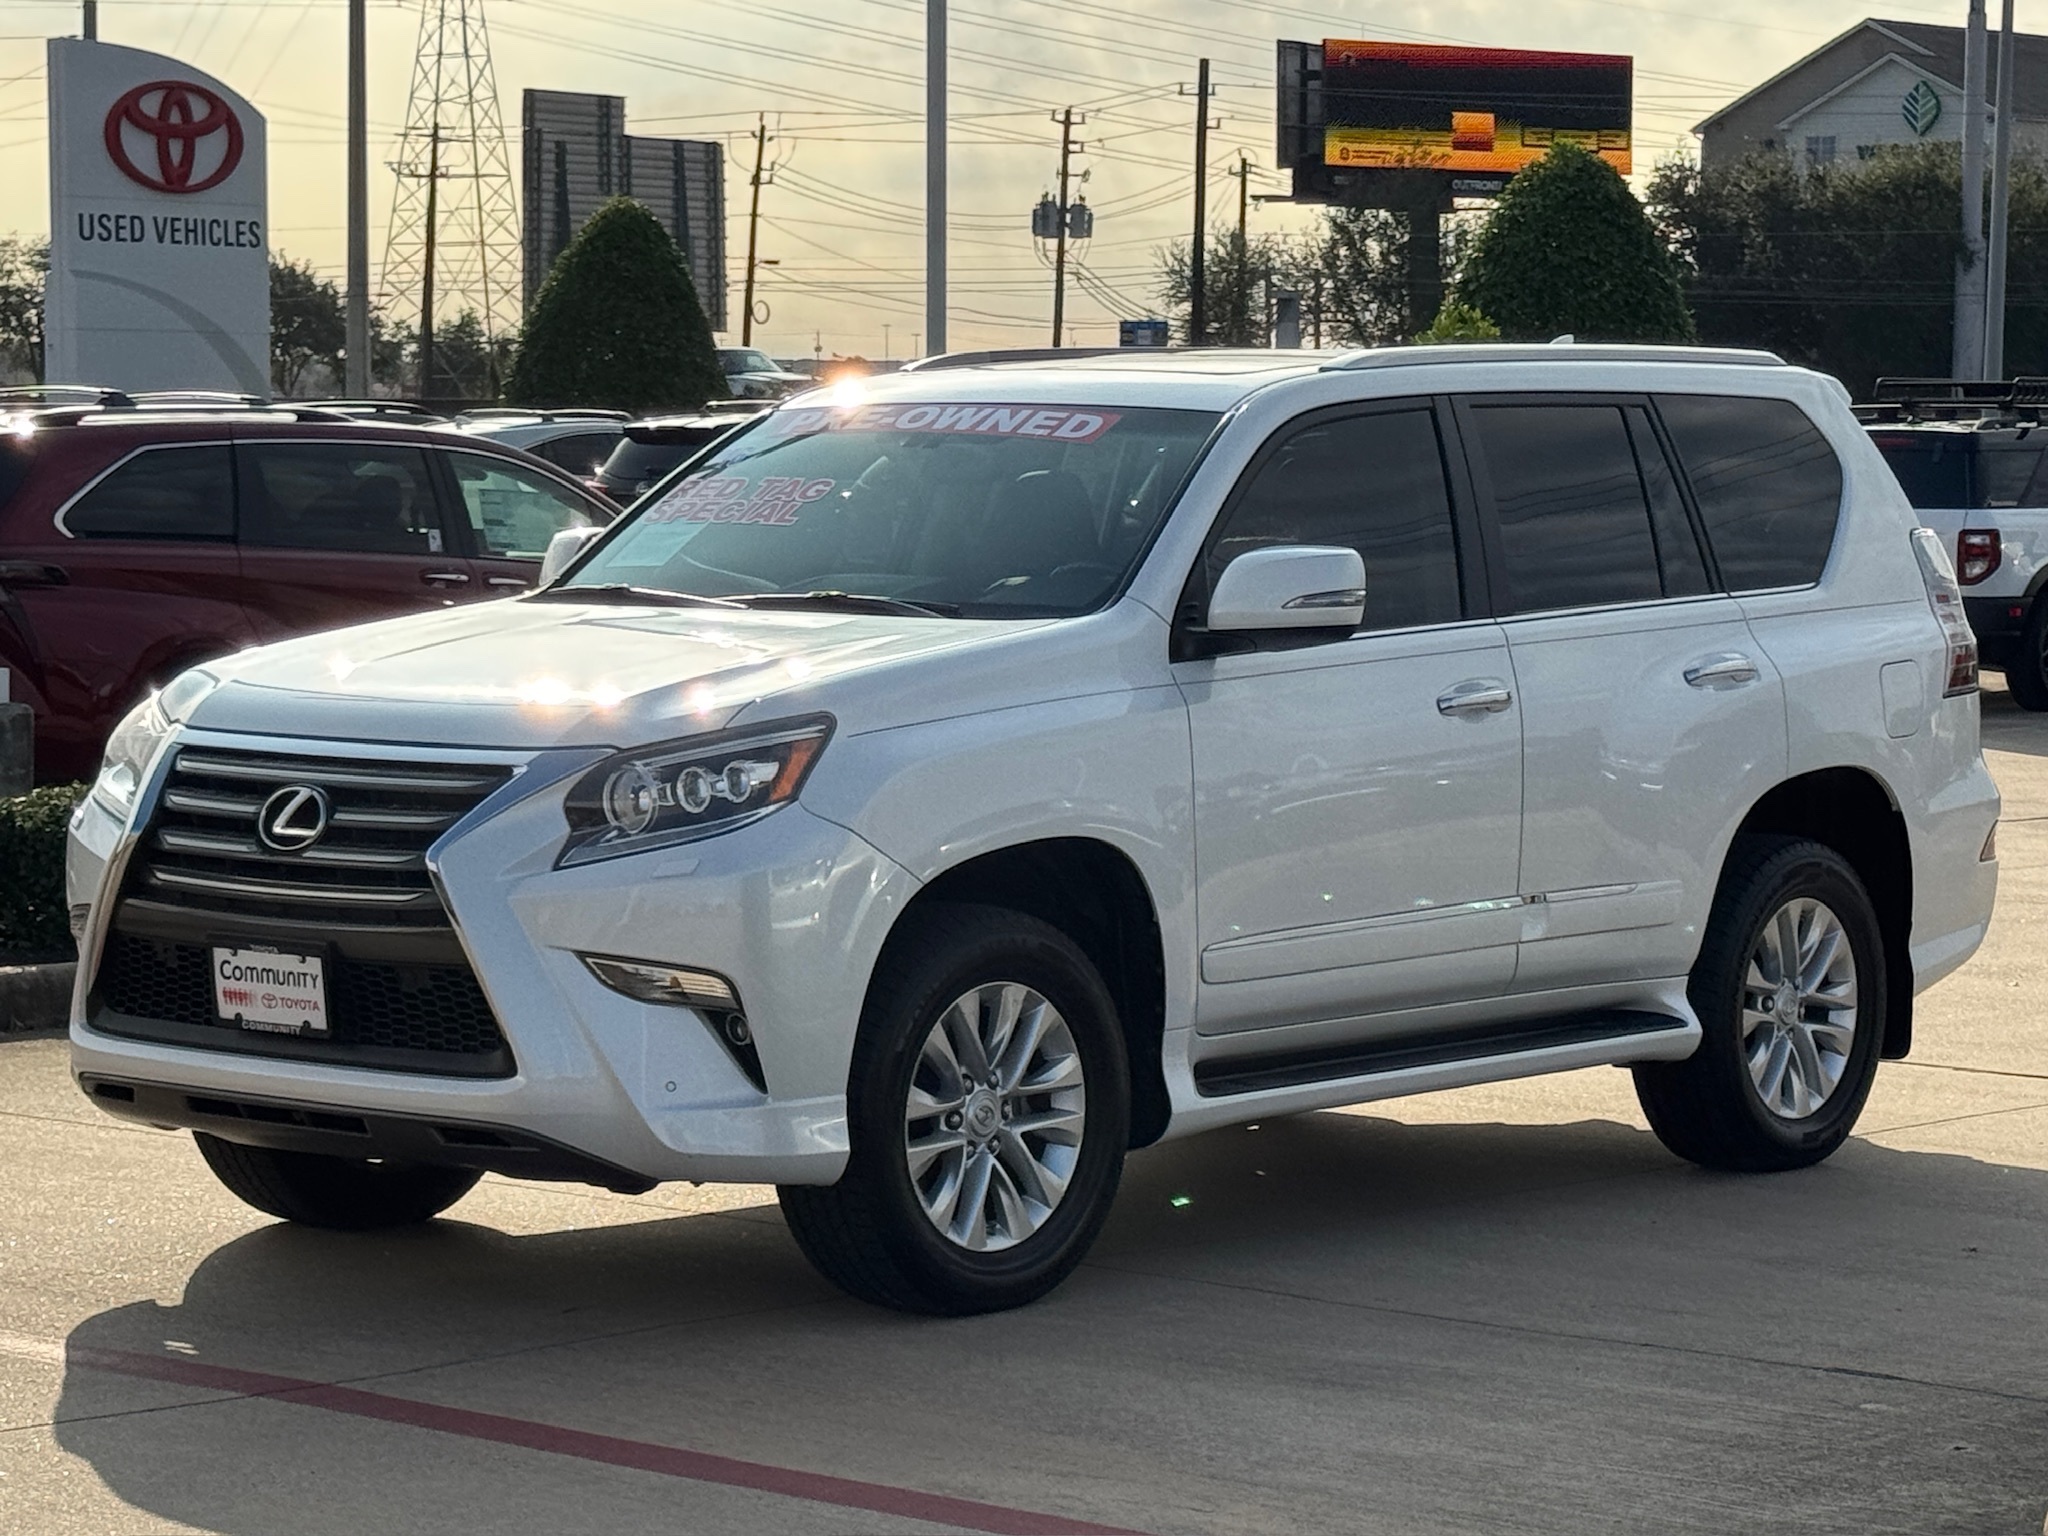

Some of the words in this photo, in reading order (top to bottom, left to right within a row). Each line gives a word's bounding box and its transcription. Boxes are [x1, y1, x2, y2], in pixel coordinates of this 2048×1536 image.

[78, 213, 145, 243] USED
[152, 216, 261, 249] VEHICLES
[779, 404, 1104, 439] PRE-OWNED
[663, 477, 749, 501] RED
[752, 477, 836, 502] TAG
[646, 500, 803, 526] SPECIAL
[279, 996, 320, 1012] TOYOTA
[241, 1020, 301, 1036] COMMUNITY
